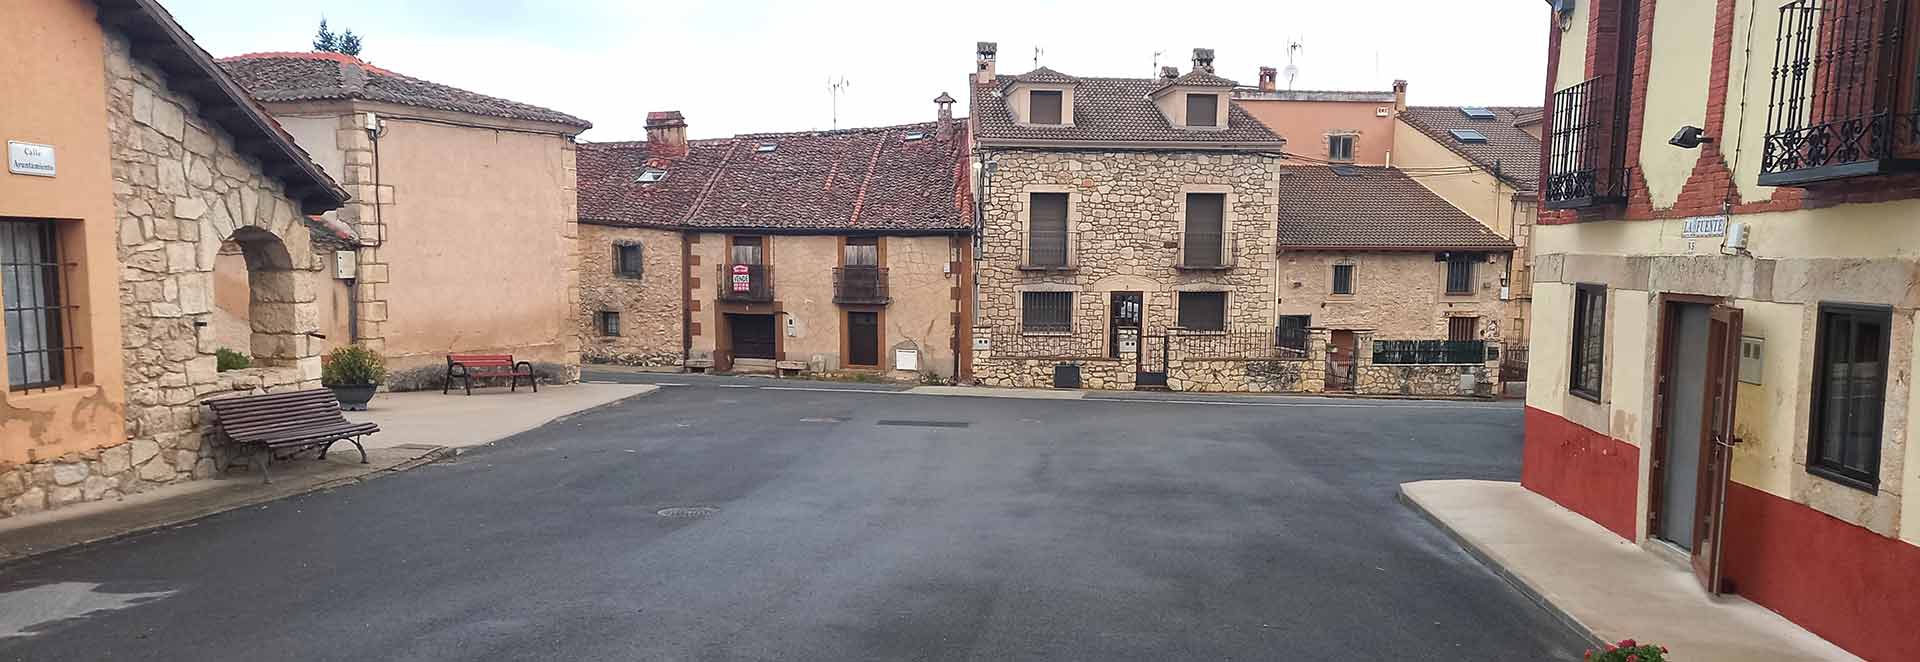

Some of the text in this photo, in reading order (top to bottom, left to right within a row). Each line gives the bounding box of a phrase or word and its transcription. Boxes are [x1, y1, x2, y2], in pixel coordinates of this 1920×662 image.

[24, 147, 41, 156] Calle
[13, 160, 54, 171] Ayuntamiento
[1684, 219, 1723, 233] LA FUENTE
